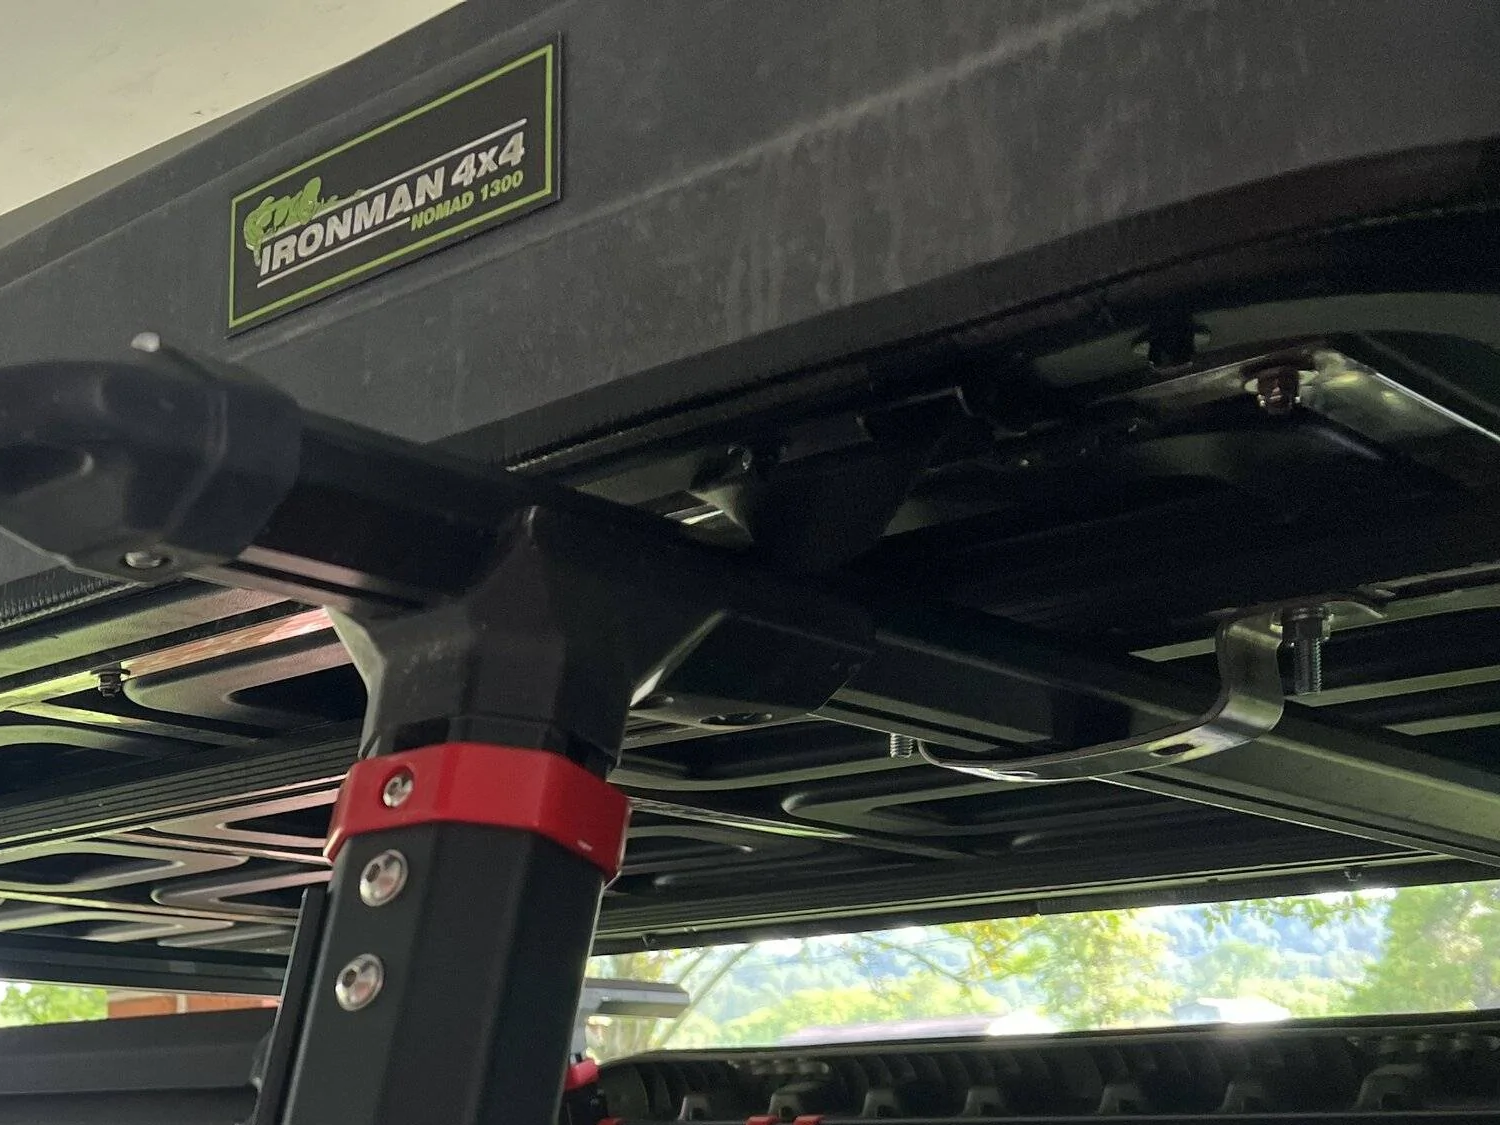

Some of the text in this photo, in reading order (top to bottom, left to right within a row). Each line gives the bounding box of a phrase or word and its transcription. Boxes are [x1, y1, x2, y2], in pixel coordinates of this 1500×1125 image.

[259, 166, 445, 277] IRONMAN
[410, 169, 525, 232] NOMAD 1300
